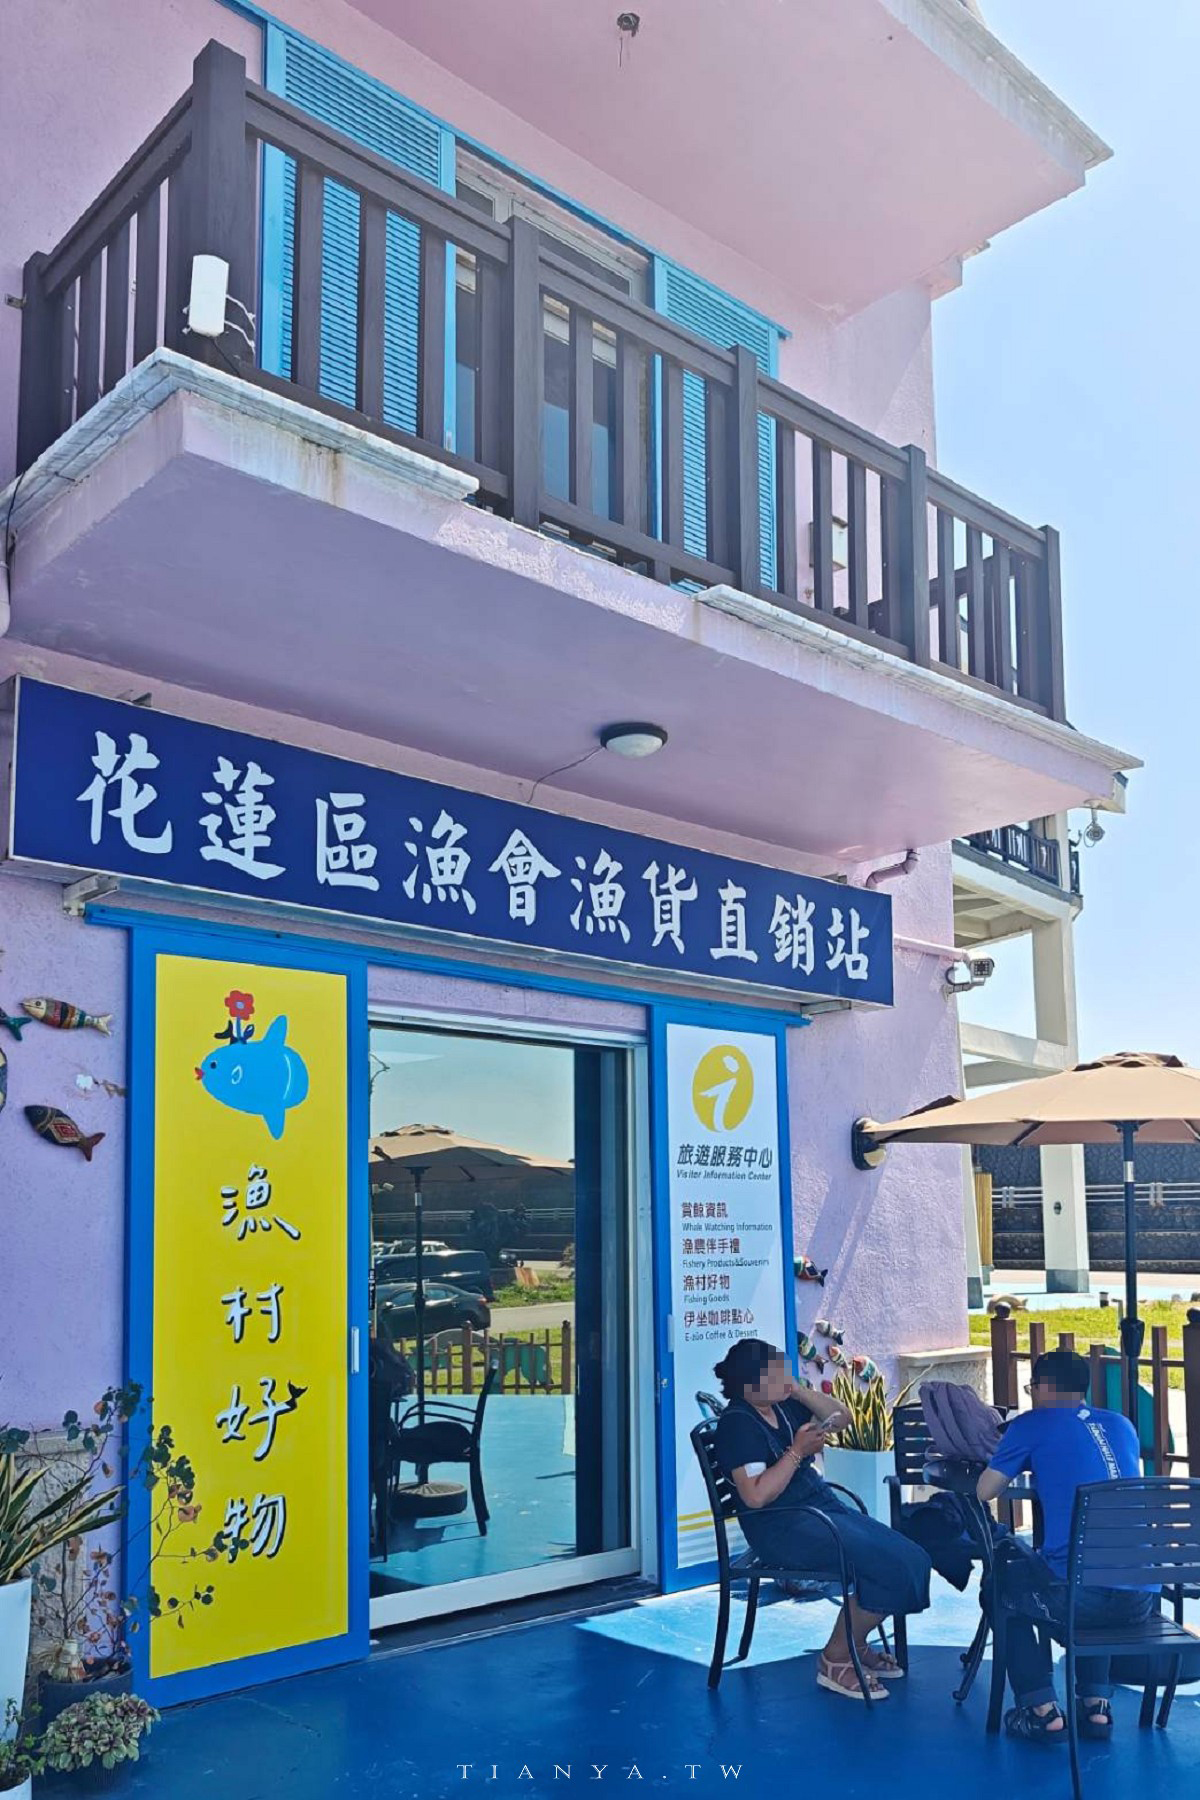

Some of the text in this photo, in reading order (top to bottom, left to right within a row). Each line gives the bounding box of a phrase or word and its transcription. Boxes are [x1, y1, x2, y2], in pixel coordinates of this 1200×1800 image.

[76, 731, 870, 980] 花蓮區漁會漁貨直銷站
[677, 1144, 772, 1168] 旅遊服務中心
[677, 1170, 772, 1180] Visitor Information Center
[682, 1202, 728, 1218] 賞鯨資訊
[682, 1222, 772, 1233] Whale Watching Information
[682, 1238, 740, 1254] 漁農伴手禮
[683, 1260, 705, 1269] Fishery
[683, 1274, 730, 1291] 漁村好物
[684, 1294, 729, 1305] Fishing Goods
[684, 1308, 754, 1328] 伊坐咖啡點心
[705, 1331, 726, 1340] Coffee
[735, 1329, 758, 1338] Dessert
[216, 1163, 304, 1564] 漁村好物
